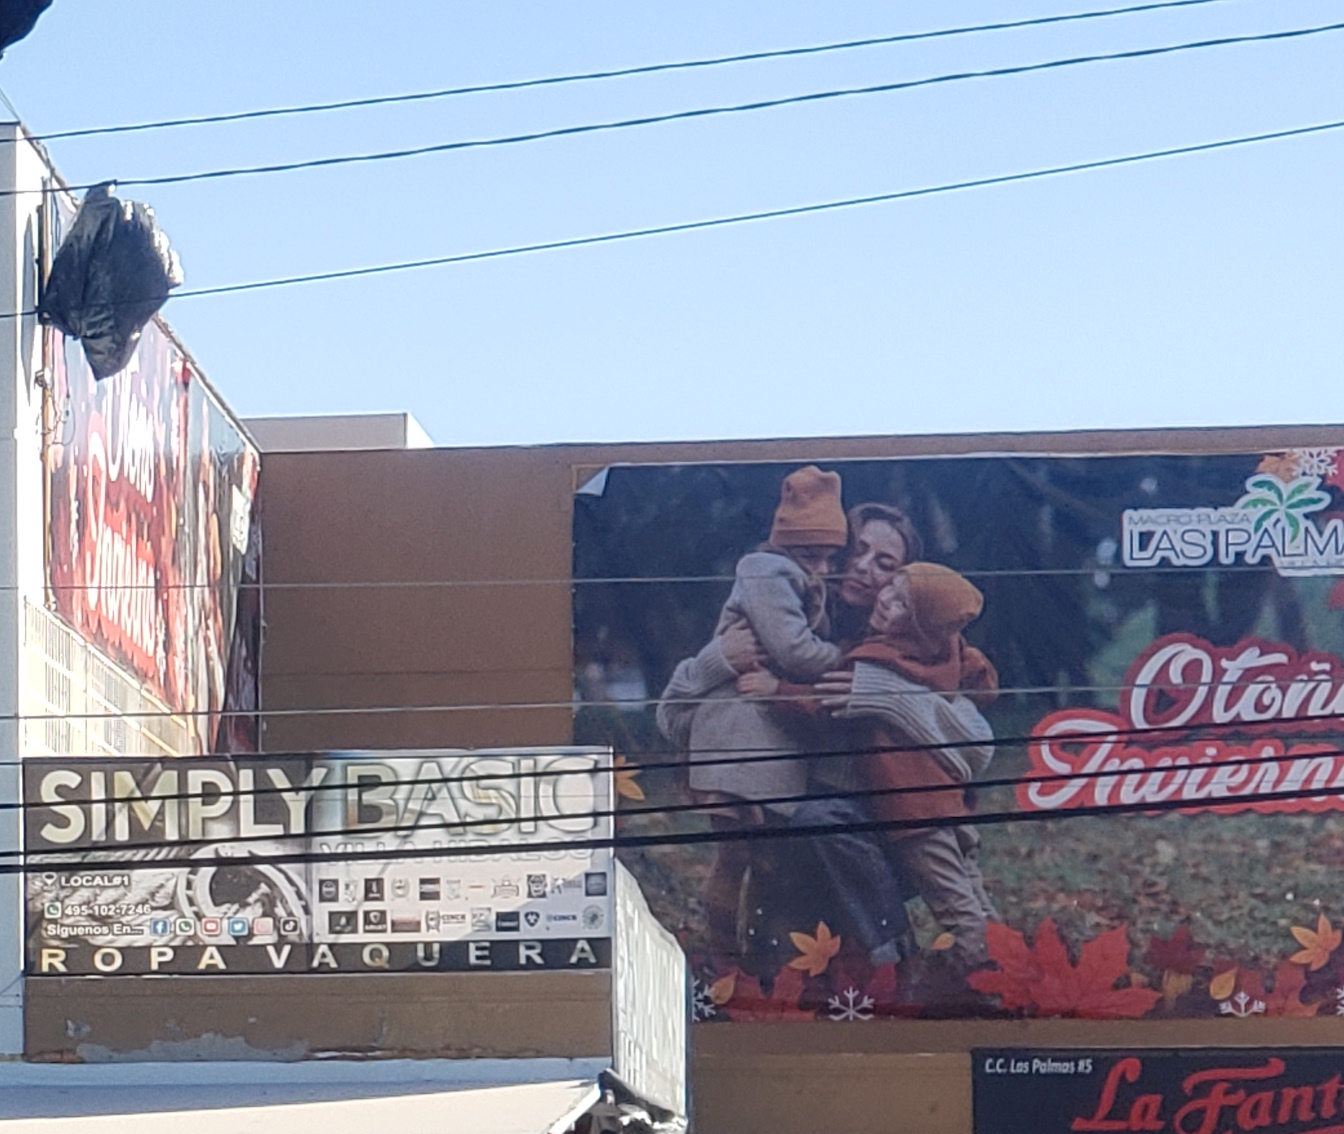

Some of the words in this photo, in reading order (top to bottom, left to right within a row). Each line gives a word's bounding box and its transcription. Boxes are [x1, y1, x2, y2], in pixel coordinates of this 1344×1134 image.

[1129, 514, 1191, 525] MACRO
[1197, 513, 1251, 524] PLAZA
[1130, 529, 1207, 560] LAS
[1225, 527, 1344, 560] PALM
[1131, 643, 1344, 730] Otoñ
[1028, 719, 1344, 808] Inviern
[39, 765, 327, 843] SIMPLY
[345, 756, 597, 839] BASIC
[61, 876, 129, 886] LOCAL#1
[64, 904, 151, 915] 495-102-7246
[41, 945, 227, 972] ROPA
[268, 940, 597, 970] VAQUERA
[985, 1058, 1007, 1073] C.C.
[1010, 1058, 1029, 1073] Las
[1032, 1058, 1075, 1074] Palmas
[1071, 1058, 1165, 1131] La
